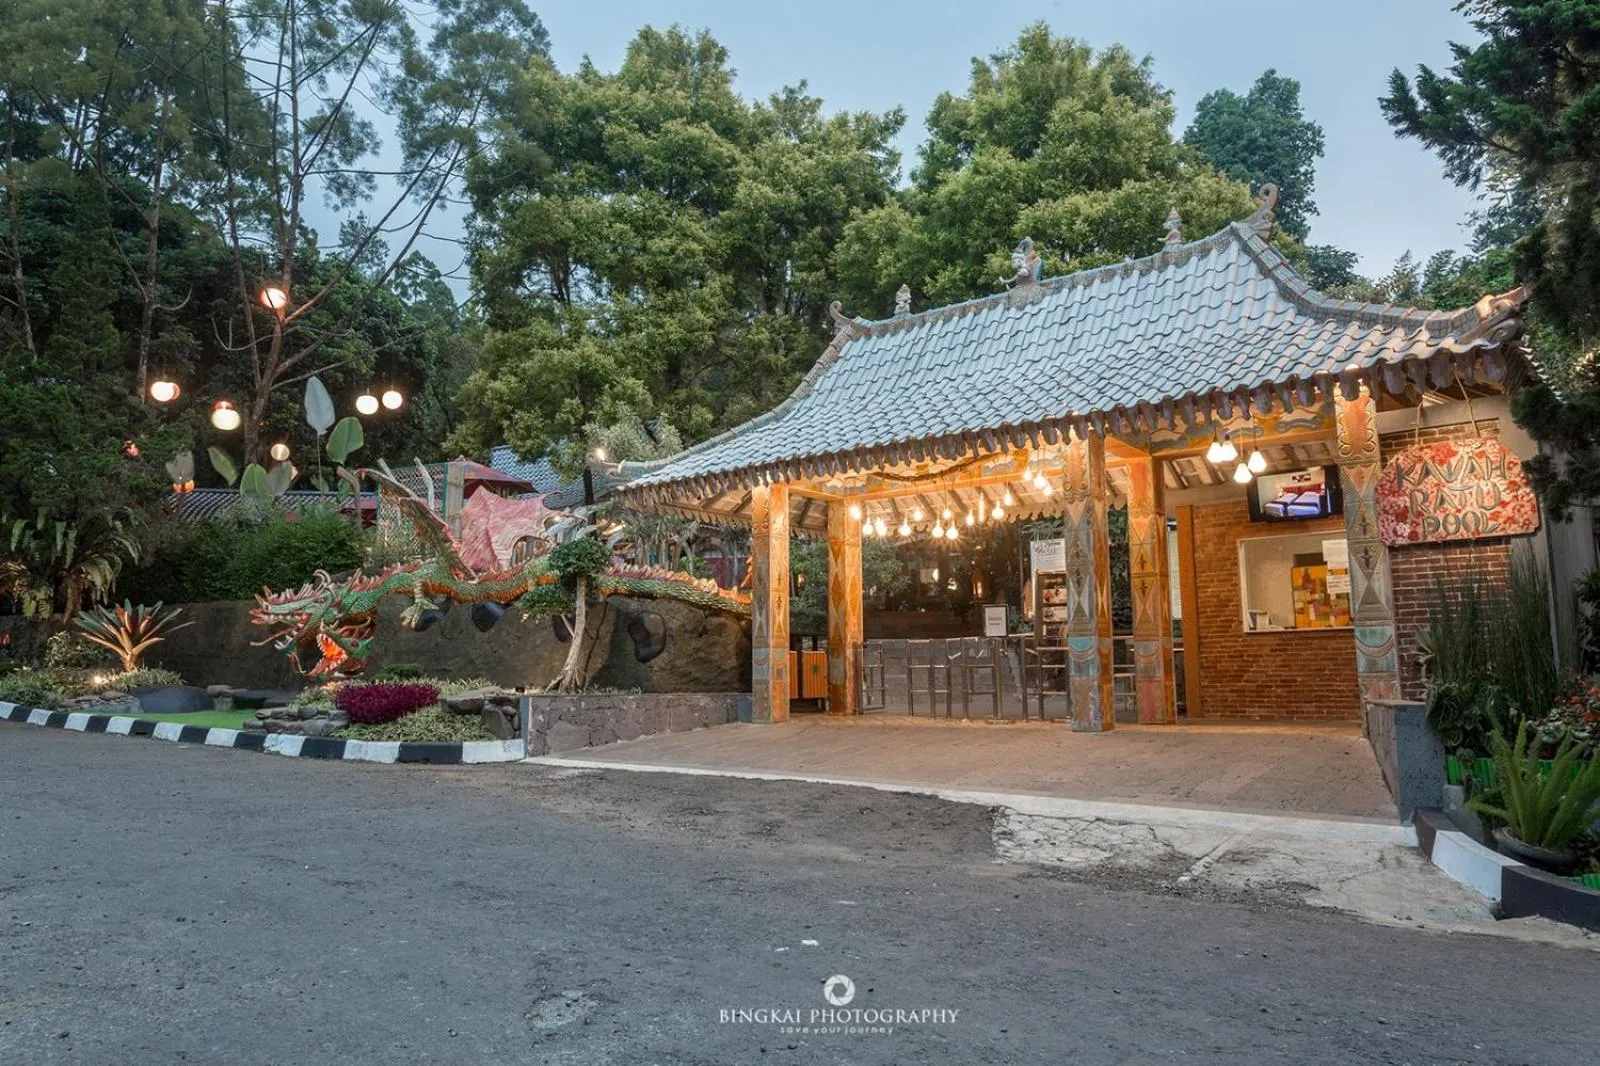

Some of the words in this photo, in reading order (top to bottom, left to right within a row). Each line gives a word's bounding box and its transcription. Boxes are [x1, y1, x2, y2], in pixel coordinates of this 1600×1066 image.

[1396, 453, 1507, 490] KAWAH
[1409, 480, 1501, 519] RATU
[1422, 510, 1501, 541] POOL
